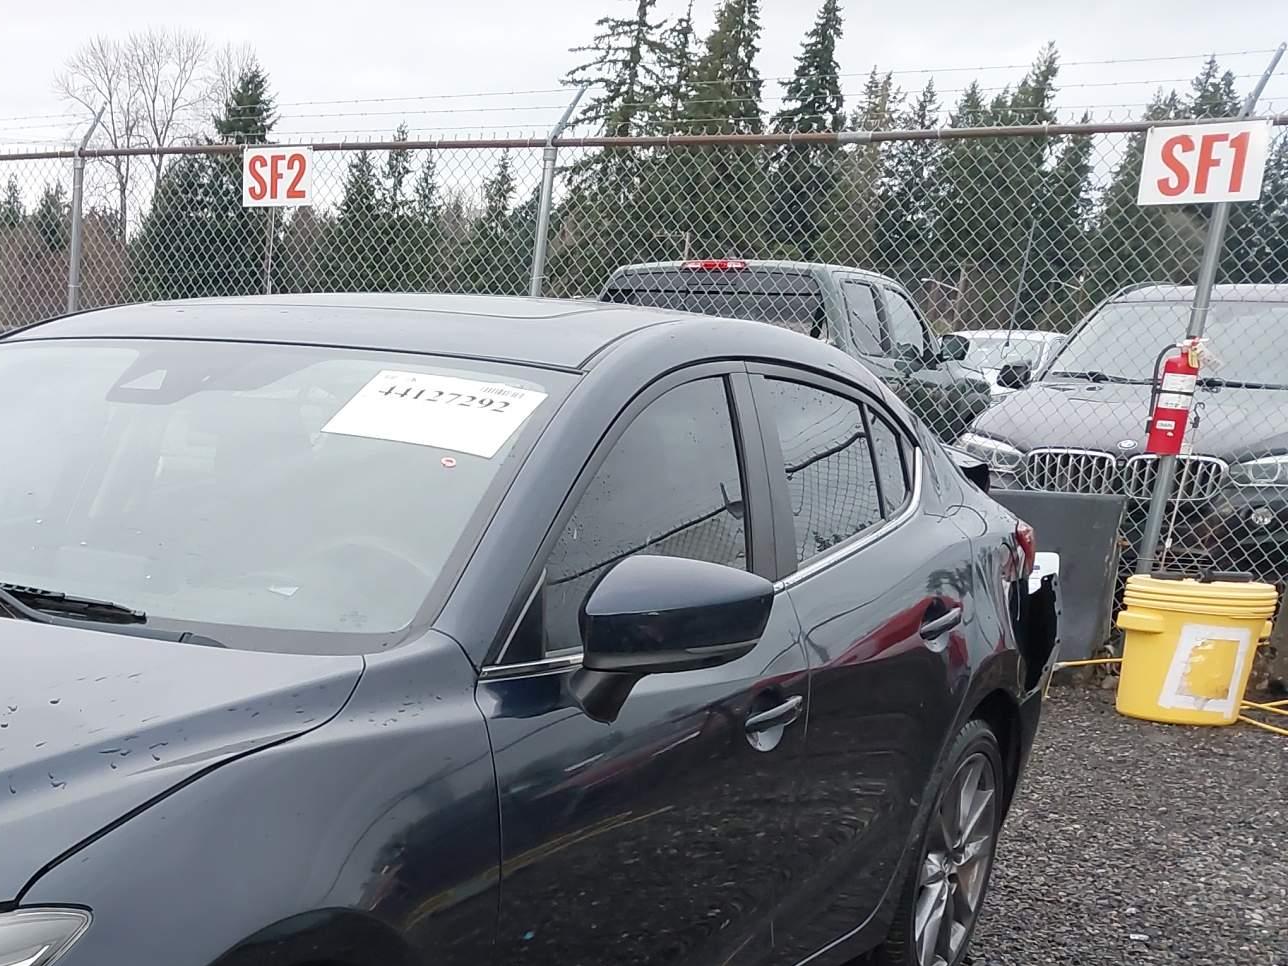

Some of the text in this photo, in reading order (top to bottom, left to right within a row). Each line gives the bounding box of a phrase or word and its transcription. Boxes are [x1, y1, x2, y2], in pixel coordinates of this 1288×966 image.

[248, 153, 307, 201] SF2
[1157, 131, 1250, 197] SF1
[378, 385, 511, 413] 44127292
